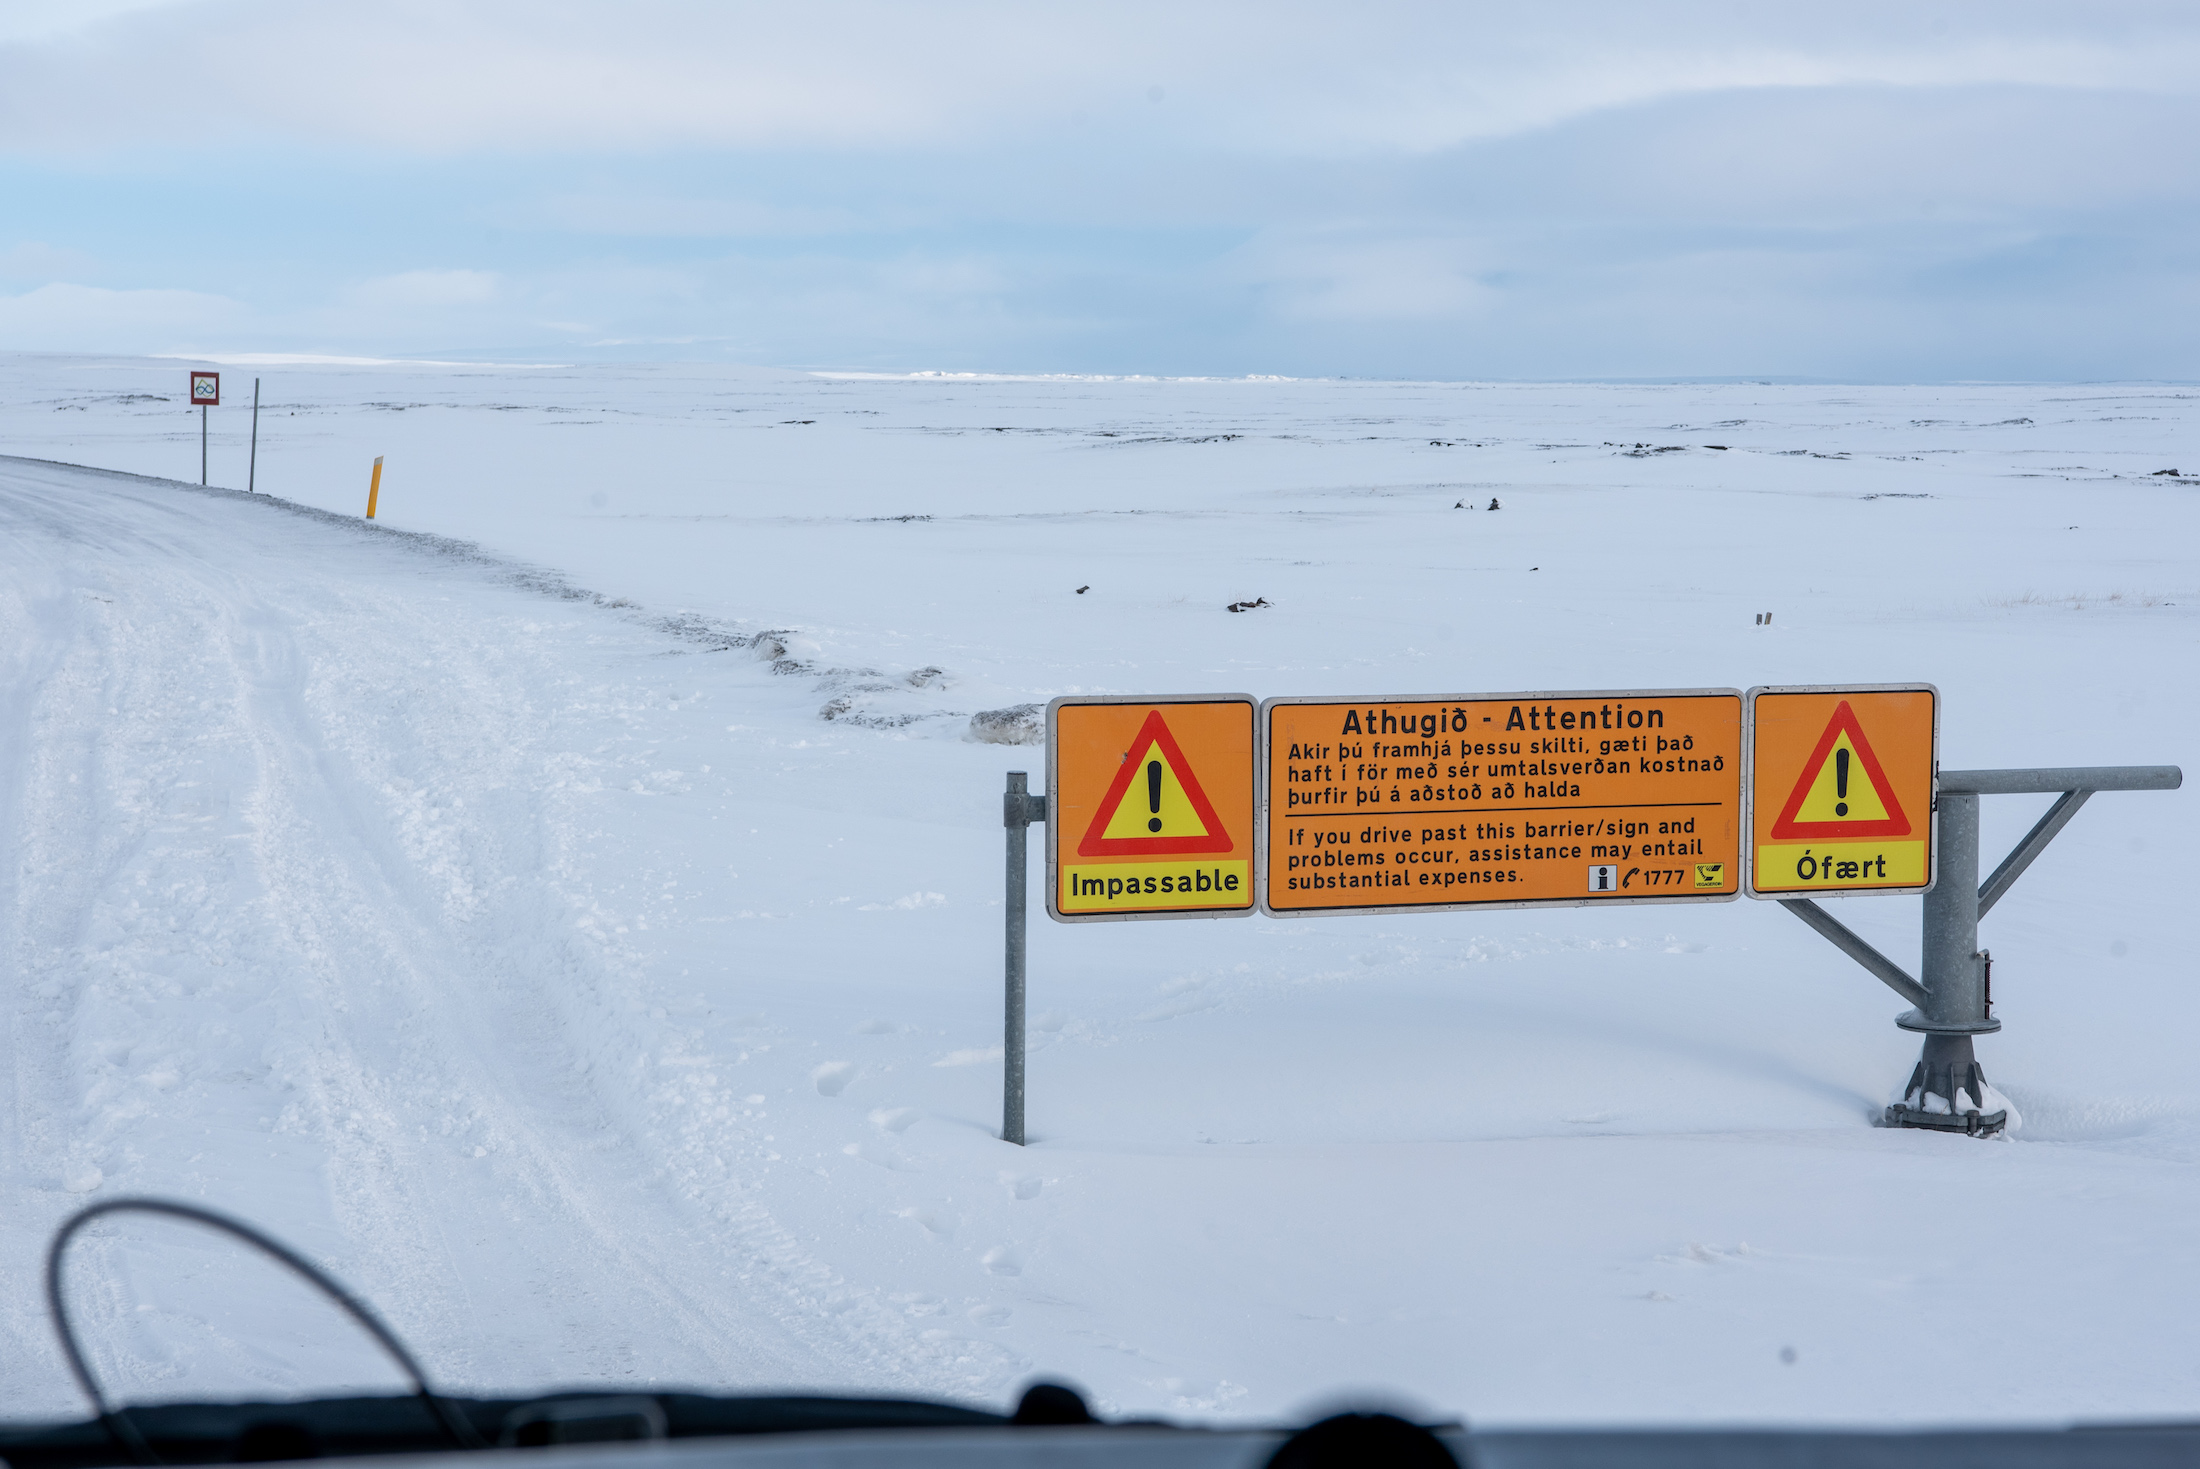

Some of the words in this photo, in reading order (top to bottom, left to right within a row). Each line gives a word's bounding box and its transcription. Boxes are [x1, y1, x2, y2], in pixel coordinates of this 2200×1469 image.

[1341, 708, 1468, 739] Athugið
[1505, 703, 1664, 732] Attention
[1288, 743, 1330, 760] Akir
[1338, 741, 1362, 763] þú
[1372, 739, 1452, 760] framhjá
[1461, 739, 1521, 760] þessu
[1530, 736, 1590, 754] skilti,
[1599, 735, 1647, 756] gæti
[1656, 734, 1694, 755] það
[1288, 764, 1332, 783] haft
[1341, 763, 1347, 781] í
[1357, 763, 1388, 781] för
[1396, 762, 1438, 780] með
[1447, 760, 1480, 779] sér
[1487, 757, 1630, 777] umtalsverðan
[1640, 755, 1724, 773] kostnað
[1288, 786, 1348, 809] þurfir
[1356, 785, 1380, 807] þú
[1390, 784, 1401, 803] á
[1410, 783, 1482, 802] aðstoð
[1491, 782, 1515, 800] að
[1524, 780, 1581, 799] halda
[1289, 828, 1305, 846] If
[1313, 831, 1351, 849] you
[1360, 825, 1412, 844] drive
[1421, 823, 1467, 845] past
[1476, 822, 1515, 840] this
[1525, 818, 1649, 839] barrier/sign
[1658, 817, 1695, 834] and
[1288, 849, 1385, 872] problems
[1395, 850, 1459, 865] occur,
[1469, 843, 1582, 862] assistance
[1591, 844, 1632, 861] may
[1641, 838, 1703, 857] entail
[1796, 849, 1886, 881] Ófært
[1072, 868, 1239, 900] Impassable
[1287, 869, 1411, 890] substantial
[1418, 870, 1523, 888] expenses.
[1643, 869, 1685, 886] 1777
